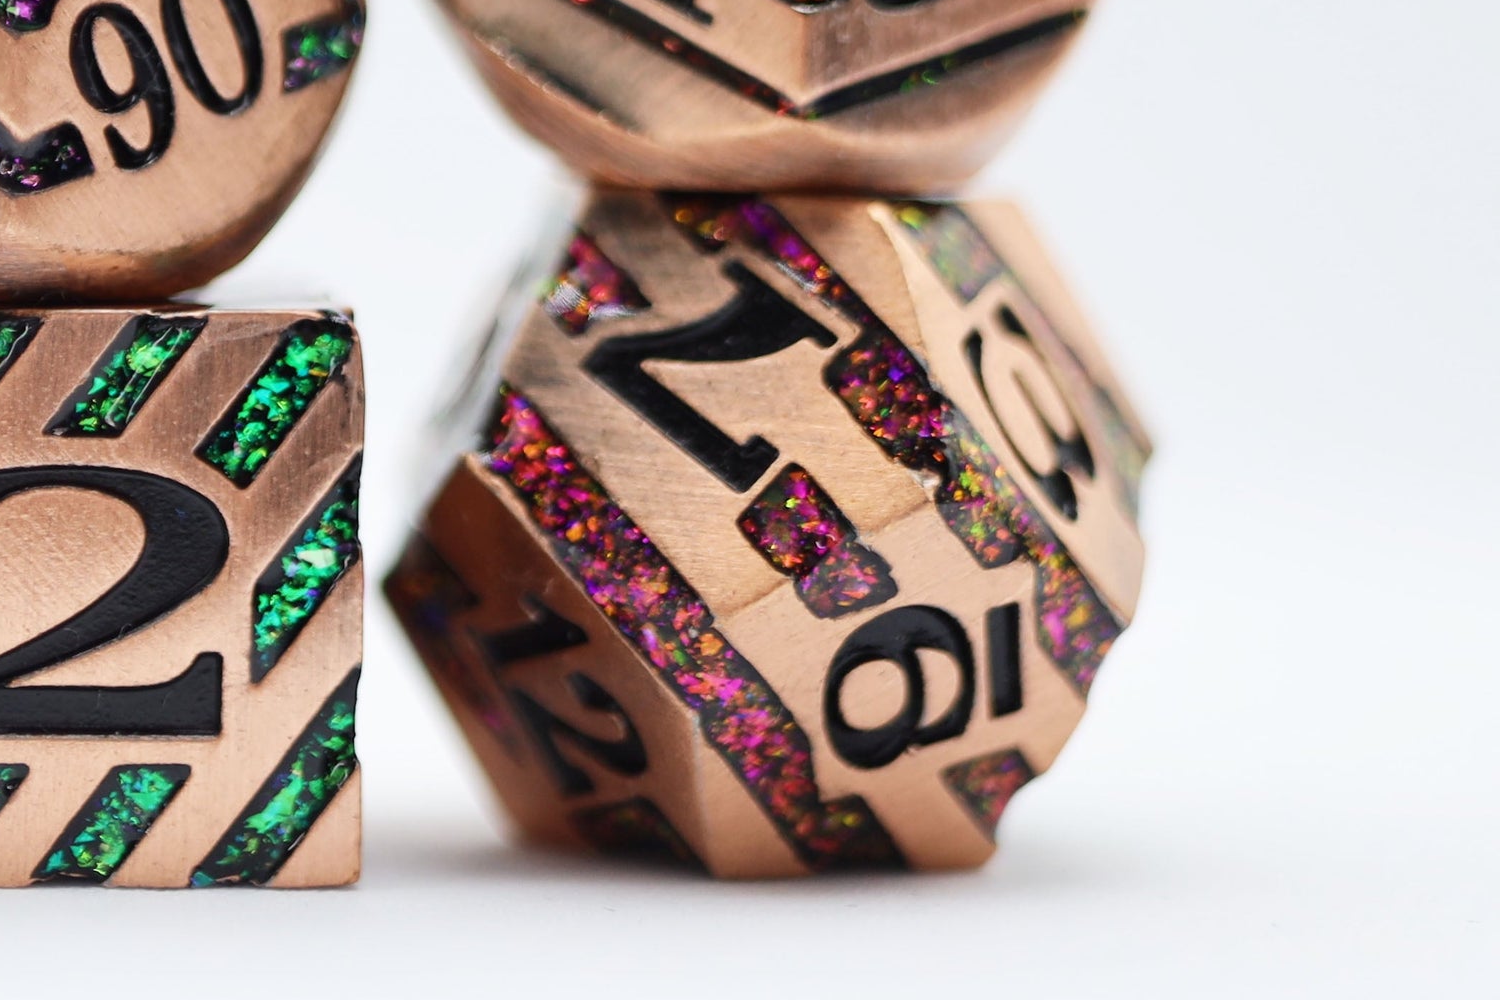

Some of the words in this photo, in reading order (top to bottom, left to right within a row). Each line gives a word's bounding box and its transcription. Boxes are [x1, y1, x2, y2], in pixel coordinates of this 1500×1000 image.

[579, 257, 840, 495] 7
[962, 302, 1097, 523] 3
[466, 592, 648, 797] 12
